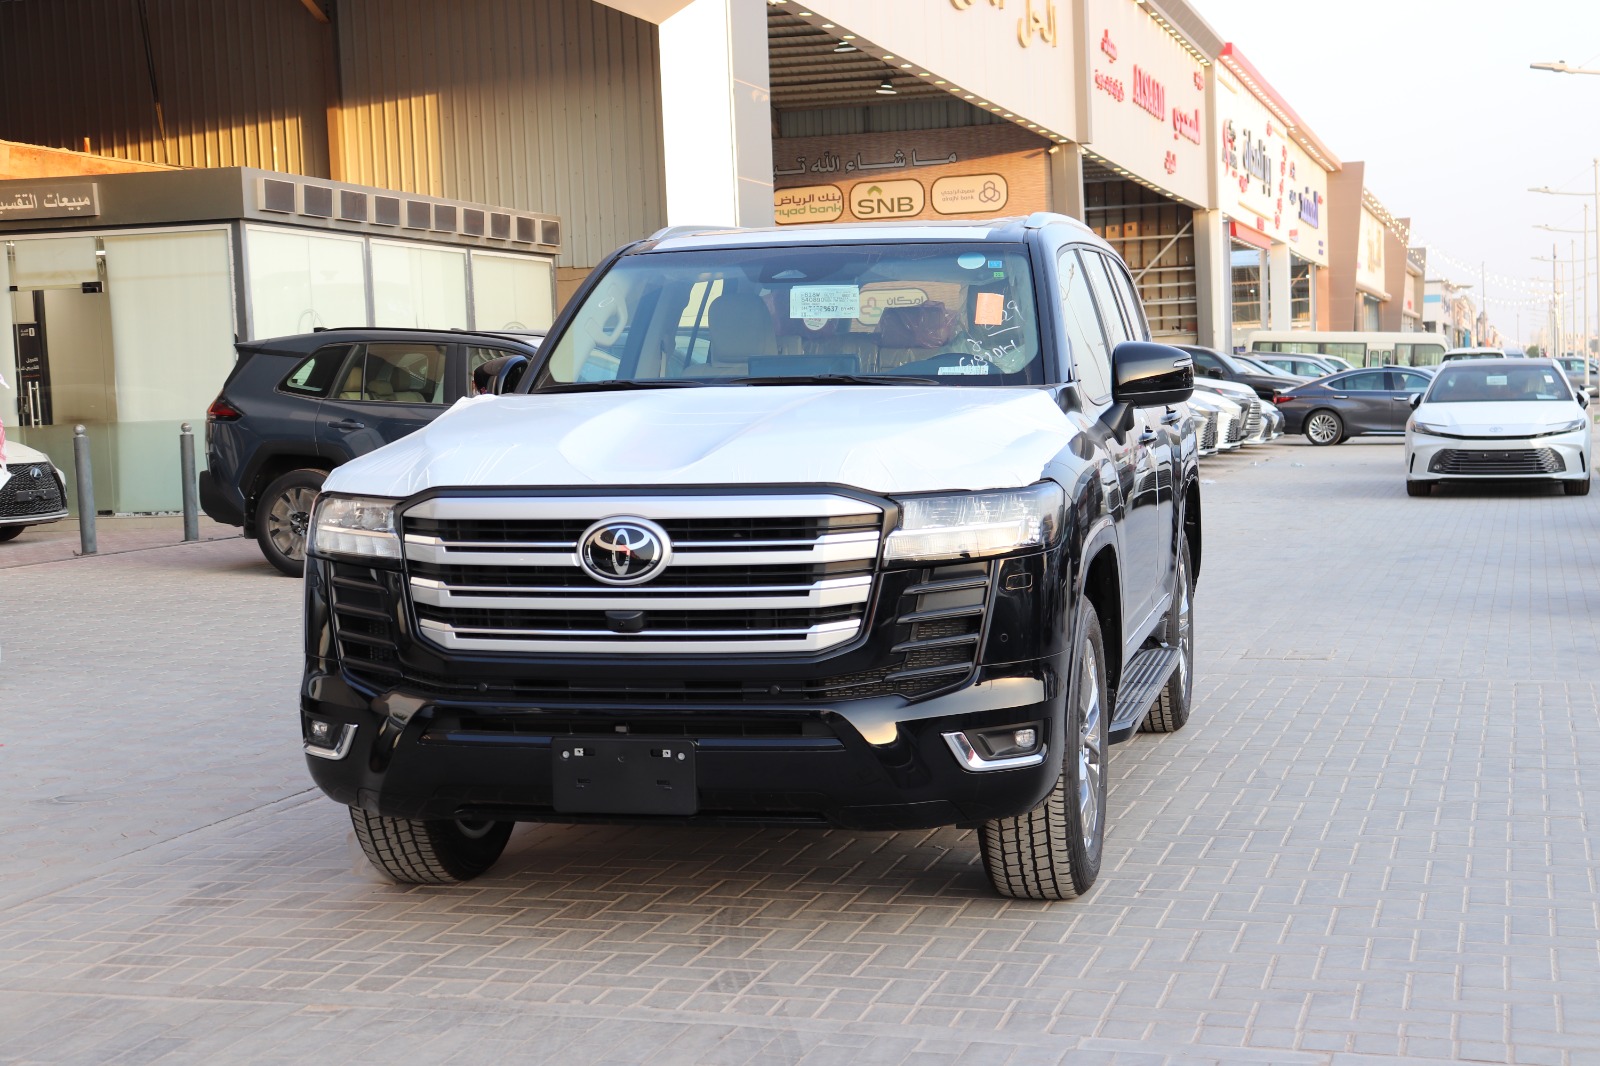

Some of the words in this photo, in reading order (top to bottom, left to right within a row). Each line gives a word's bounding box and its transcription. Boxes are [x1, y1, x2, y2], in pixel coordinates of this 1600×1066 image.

[810, 151, 840, 173] الله
[845, 150, 906, 174] شاء
[911, 149, 957, 166] ما
[0, 193, 38, 214] التقسي
[43, 193, 91, 211] مبيعات
[818, 193, 841, 203] بنك
[857, 197, 914, 214] SNB
[809, 203, 841, 213] bank
